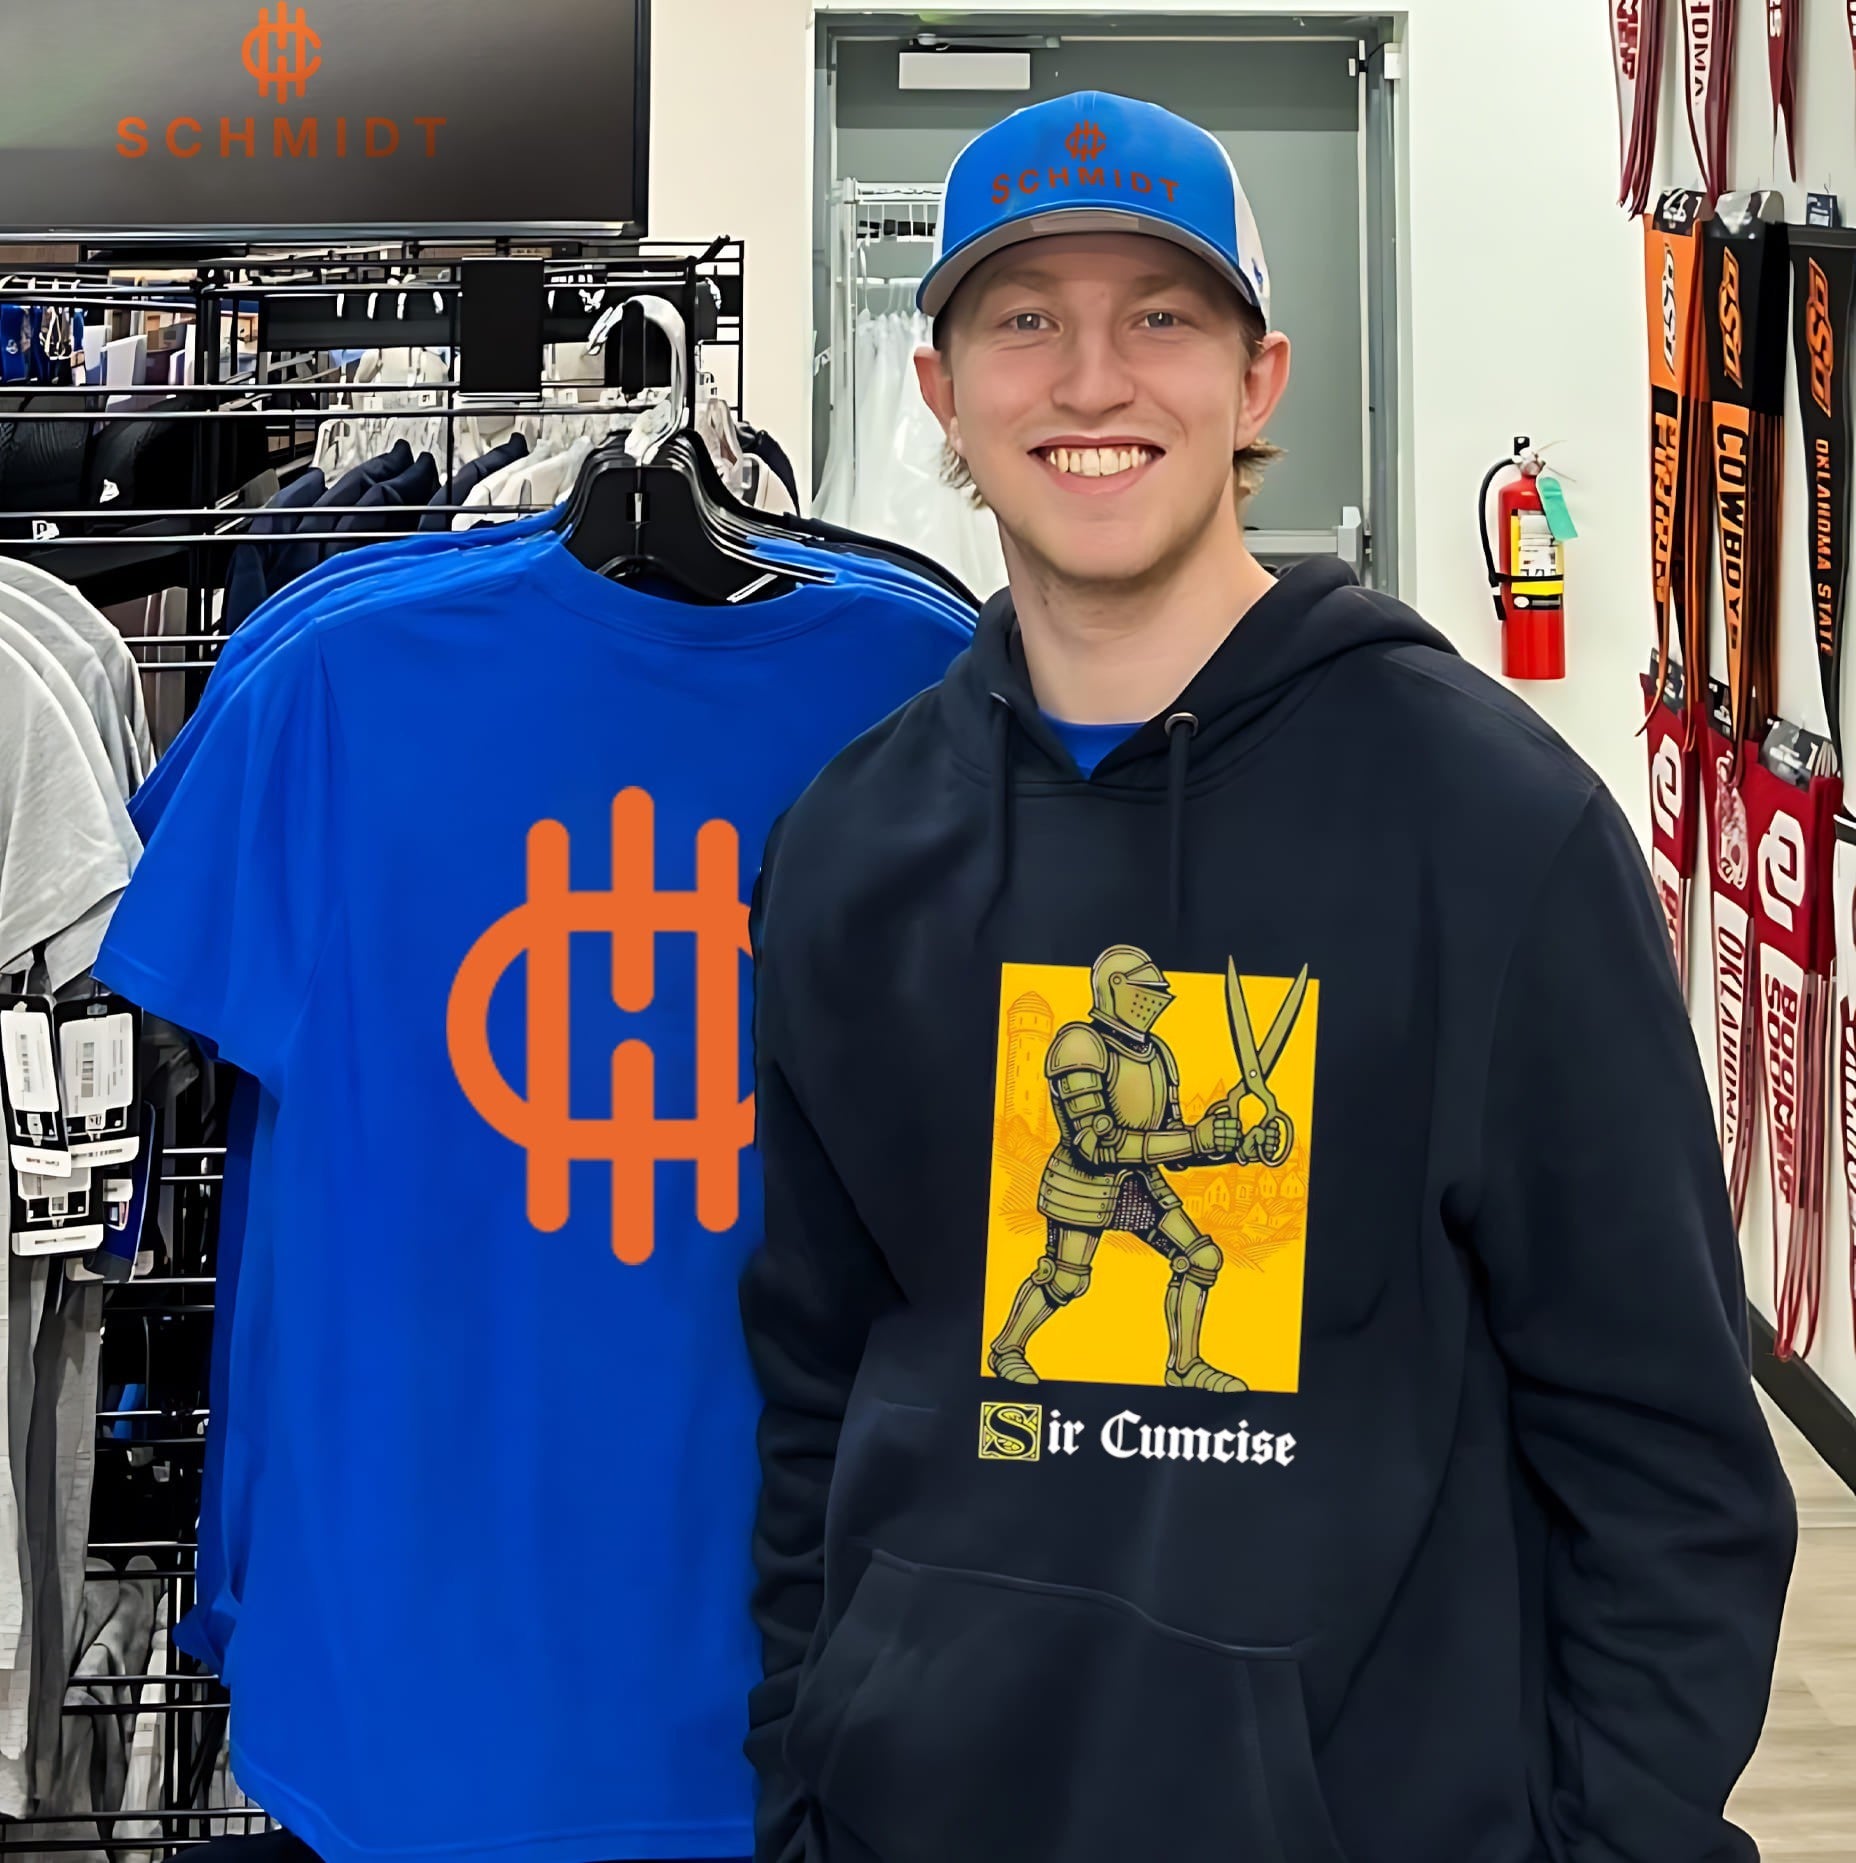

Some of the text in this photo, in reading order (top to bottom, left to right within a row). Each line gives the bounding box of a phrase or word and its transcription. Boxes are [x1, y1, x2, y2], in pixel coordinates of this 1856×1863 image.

[115, 116, 448, 159] SCHMIDT
[991, 167, 1180, 205] SCHMIDT
[1814, 438, 1833, 571] OKLAHOMA
[1717, 925, 1745, 1145] OKLAHOMA
[978, 1401, 1298, 1467] Sir Cumcise
